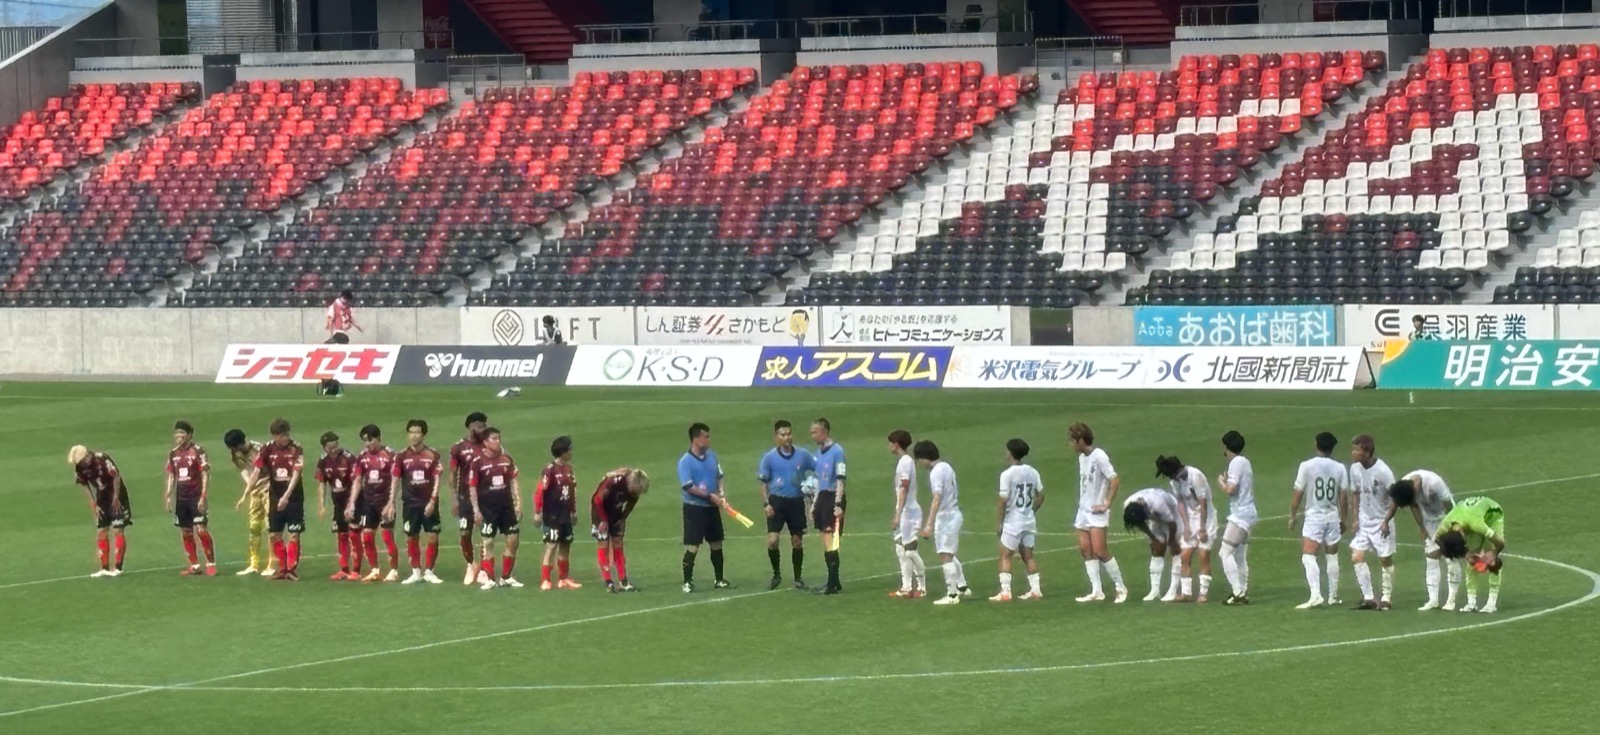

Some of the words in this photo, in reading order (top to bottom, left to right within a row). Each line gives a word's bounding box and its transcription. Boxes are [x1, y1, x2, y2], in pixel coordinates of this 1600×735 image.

[534, 317, 600, 341] LFT
[646, 315, 702, 334] しん証券
[728, 316, 786, 334] さかもと
[1178, 310, 1331, 346] あおば歯科
[225, 348, 390, 380] ショセキ
[450, 353, 543, 377] hummel
[978, 359, 1142, 381] 米沢電気グループ
[1202, 355, 1350, 383] 北國新聞社
[1444, 343, 1600, 387] 明治安
[1315, 476, 1335, 502] 88
